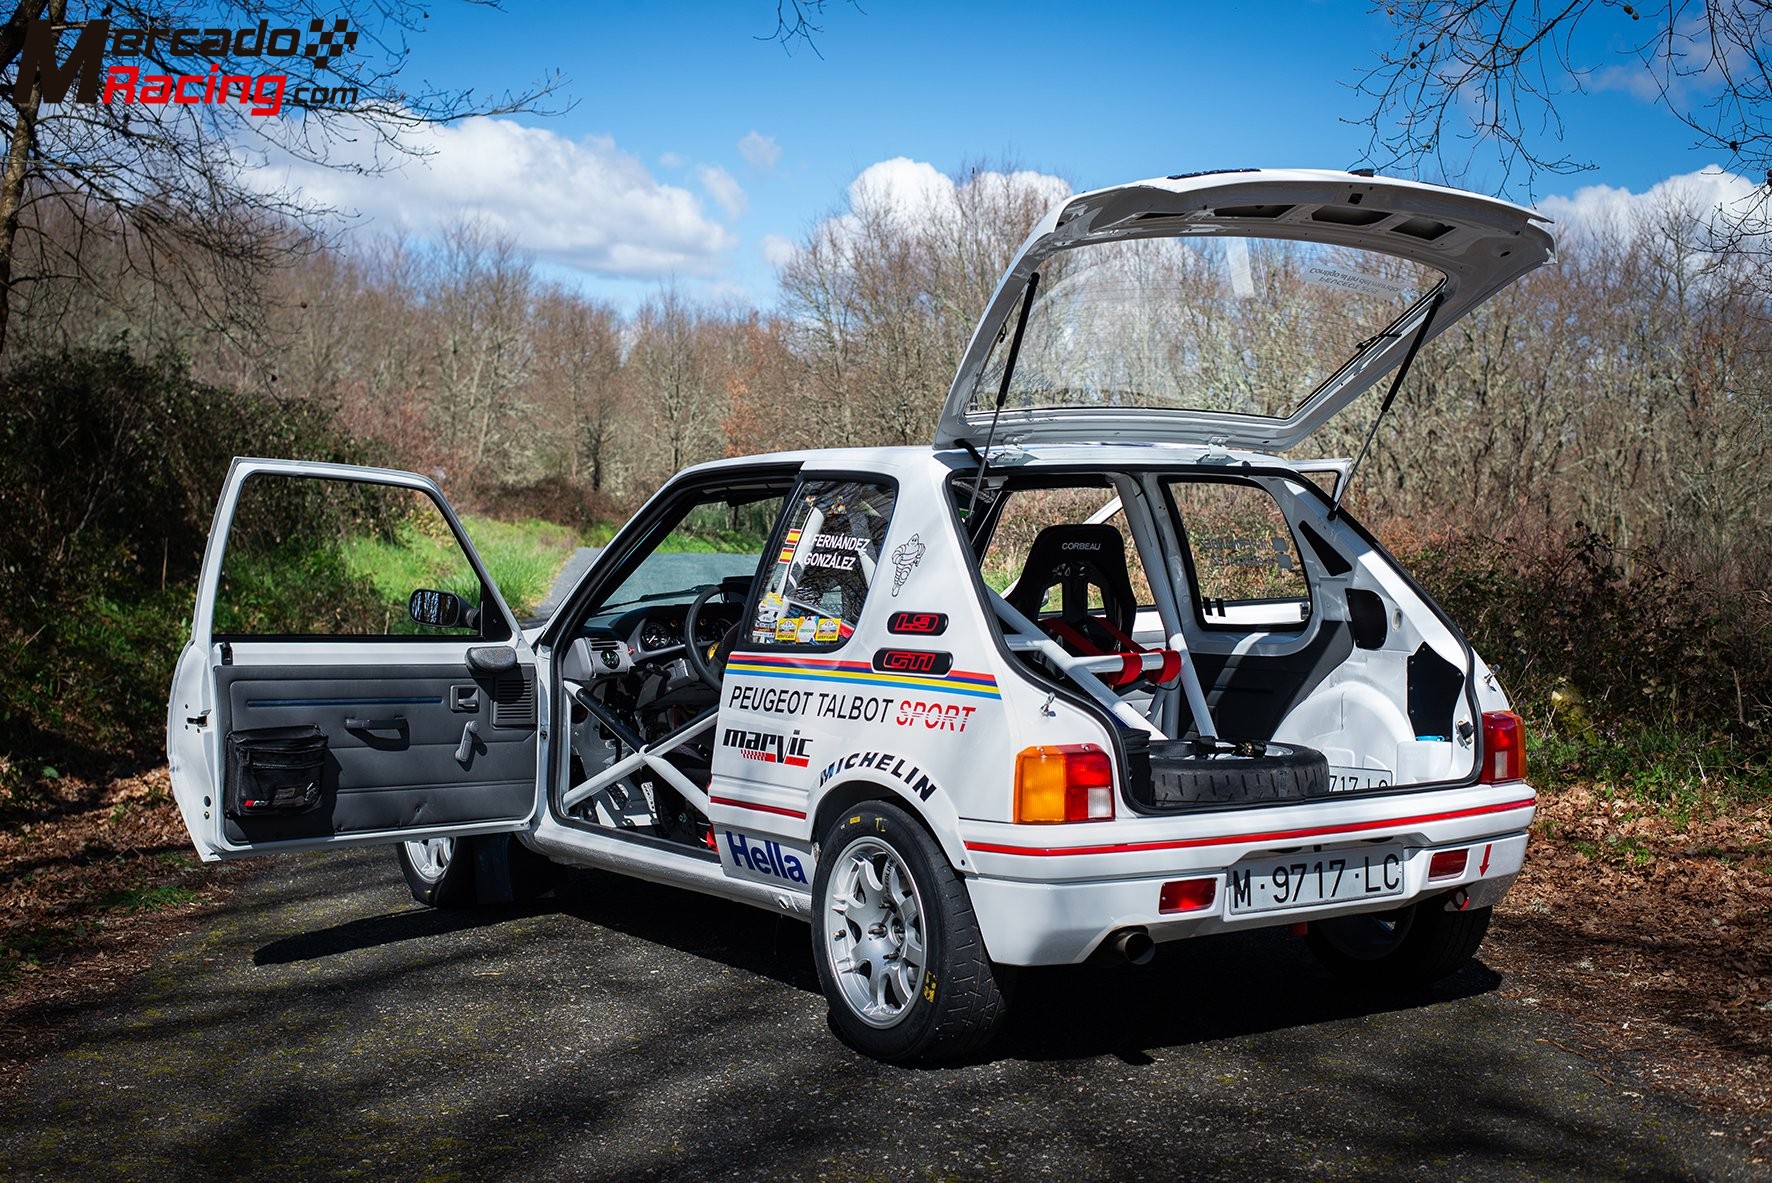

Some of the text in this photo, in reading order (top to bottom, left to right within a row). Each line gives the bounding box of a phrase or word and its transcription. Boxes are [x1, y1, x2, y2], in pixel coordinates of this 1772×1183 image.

[812, 532, 871, 551] FERNÁNDEZ
[1061, 542, 1101, 551] CORBEAU
[804, 552, 856, 571] GONZÁLEZ
[883, 650, 936, 672] GTI
[728, 685, 976, 732] PEUGEOT TALBOT SPORT
[723, 728, 813, 764] marvic
[820, 751, 937, 803] MICHELIN
[725, 830, 808, 884] Hella
